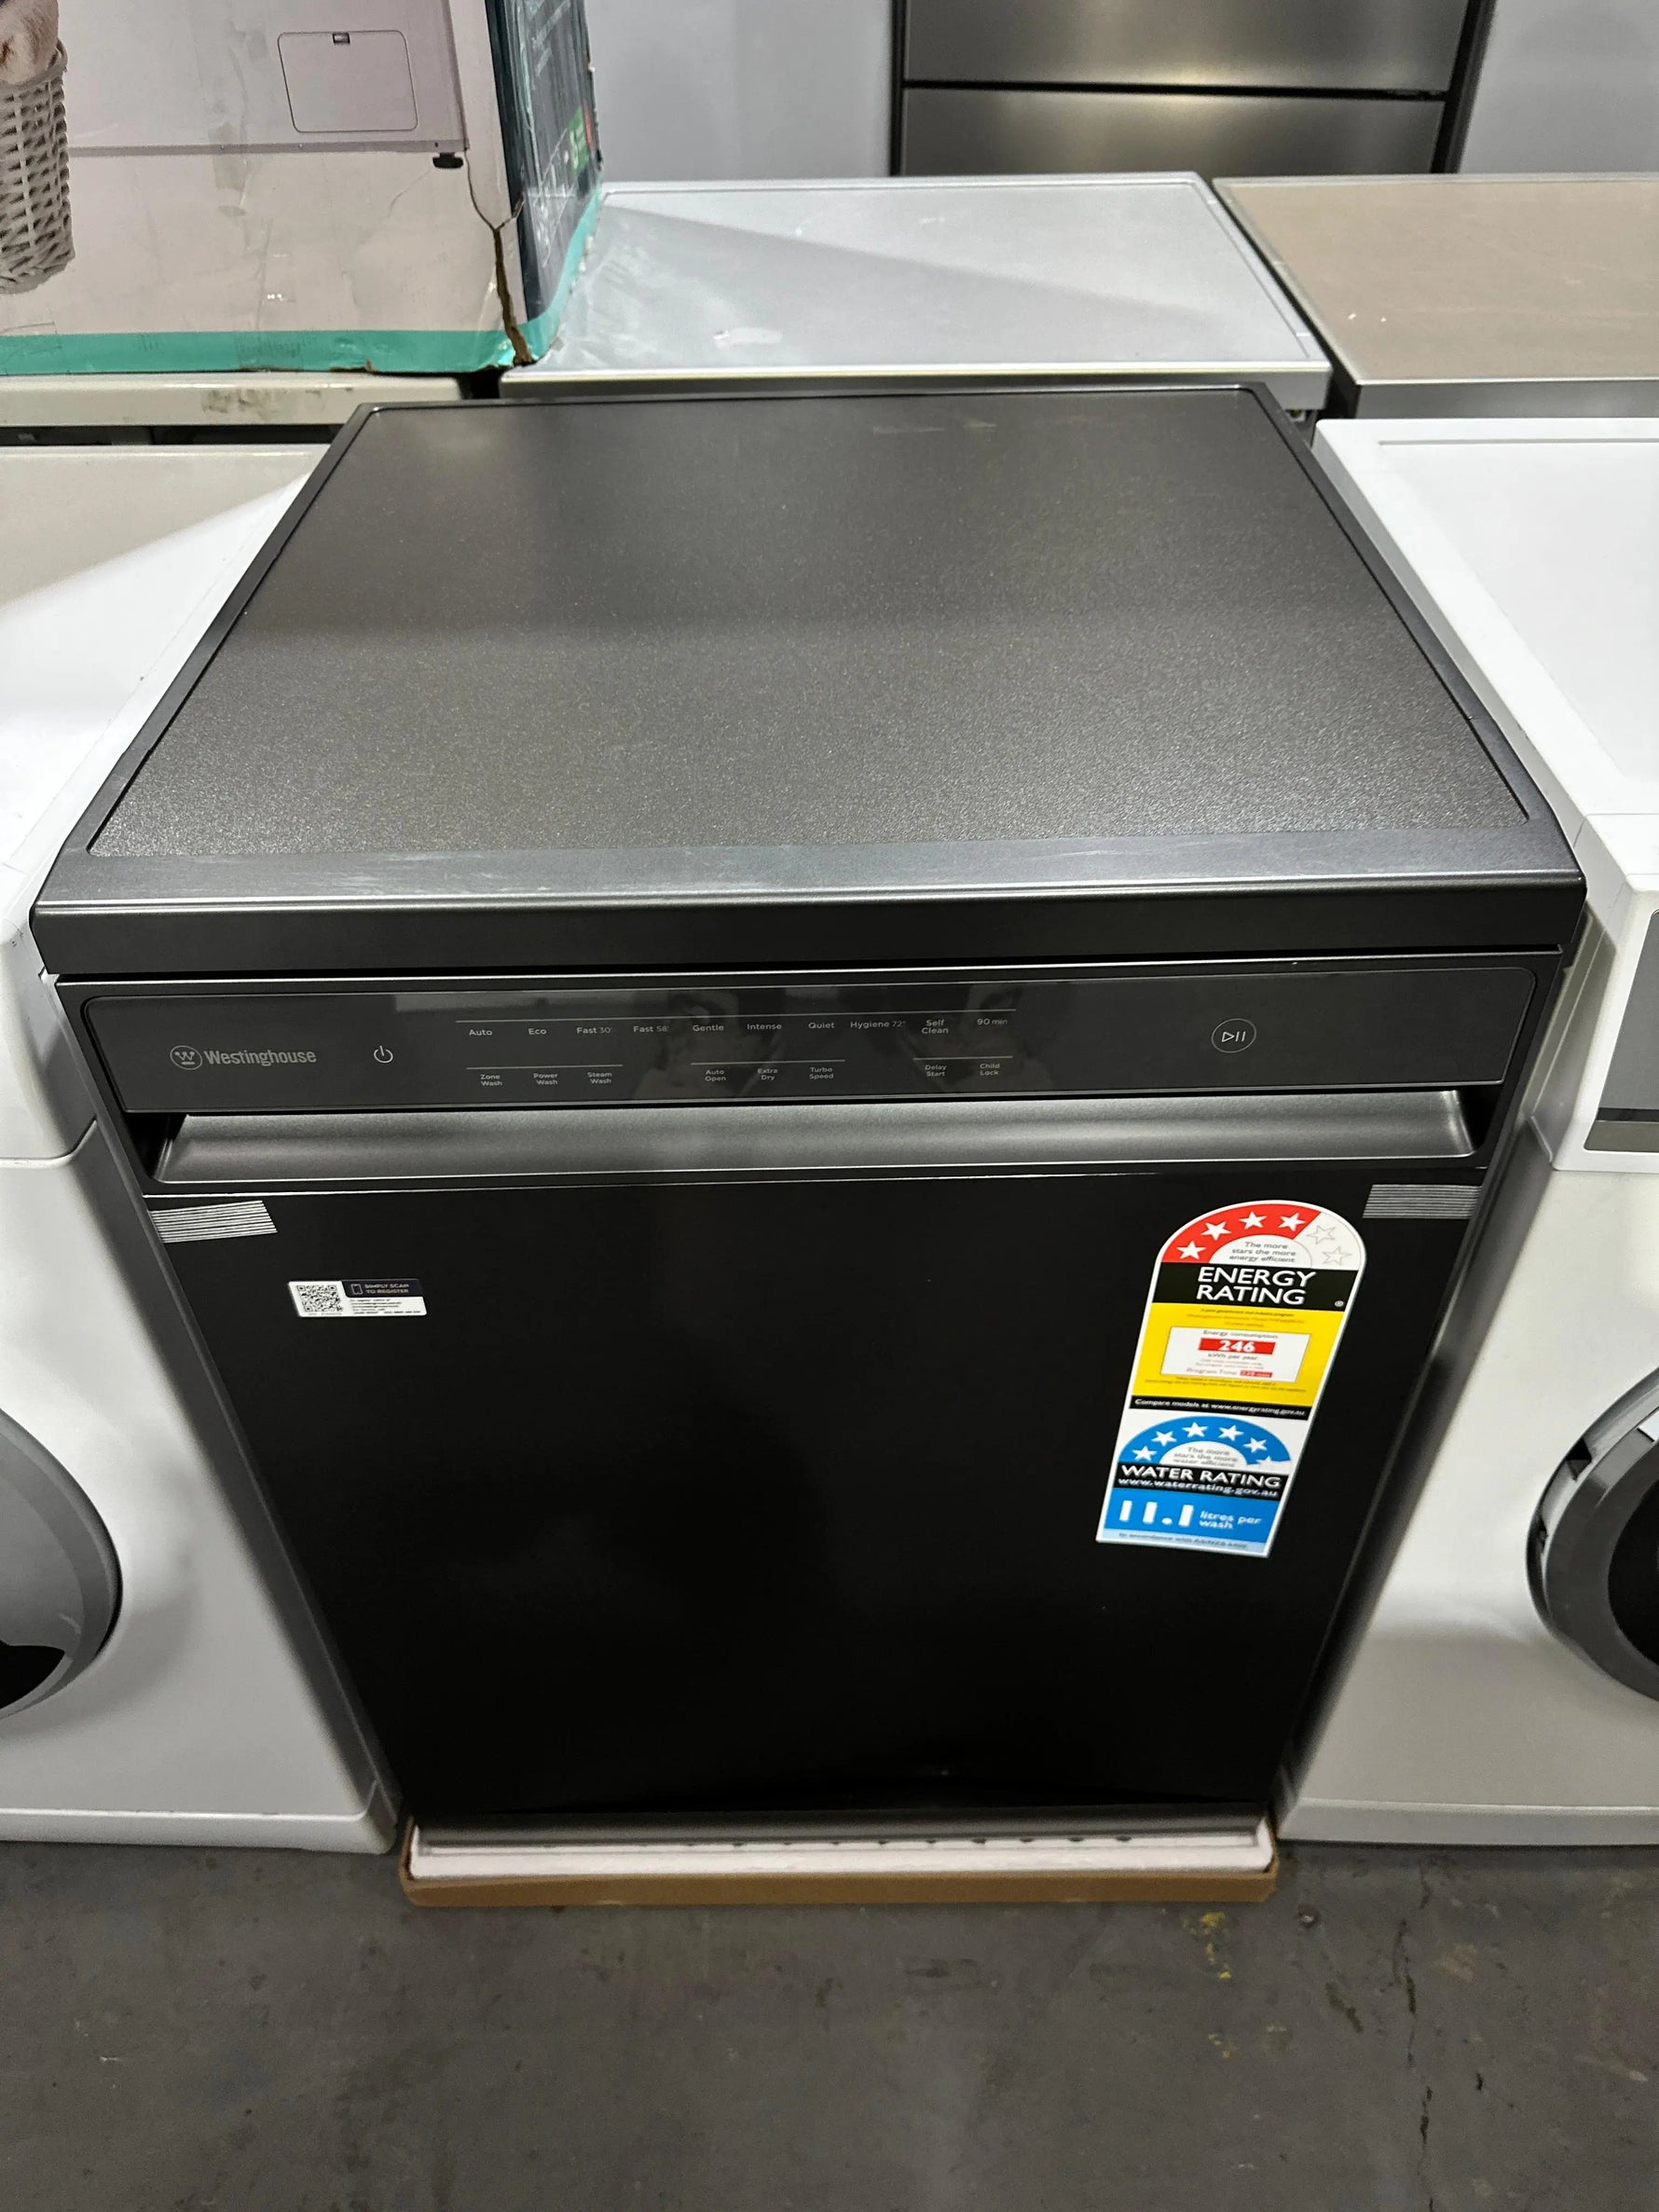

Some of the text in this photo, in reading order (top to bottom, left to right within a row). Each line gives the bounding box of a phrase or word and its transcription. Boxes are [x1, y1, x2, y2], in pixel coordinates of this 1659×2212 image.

[528, 1027, 547, 1036] Eco
[808, 1022, 835, 1030] Quiet
[850, 1021, 890, 1029] Hygiene
[469, 1028, 492, 1037] Auto
[203, 1050, 317, 1066] Westinghouse
[1198, 1267, 1316, 1287] ENERGY
[1196, 1285, 1306, 1305] RATING
[1218, 1340, 1255, 1353] 246
[1134, 1398, 1170, 1408] Compare
[1121, 1464, 1282, 1488] WATER RATING
[1117, 1477, 1279, 1497] www.waterrating.gov.au
[1119, 1500, 1194, 1527] 11.1
[1200, 1510, 1262, 1525] litres per
[1199, 1519, 1234, 1529] wash
